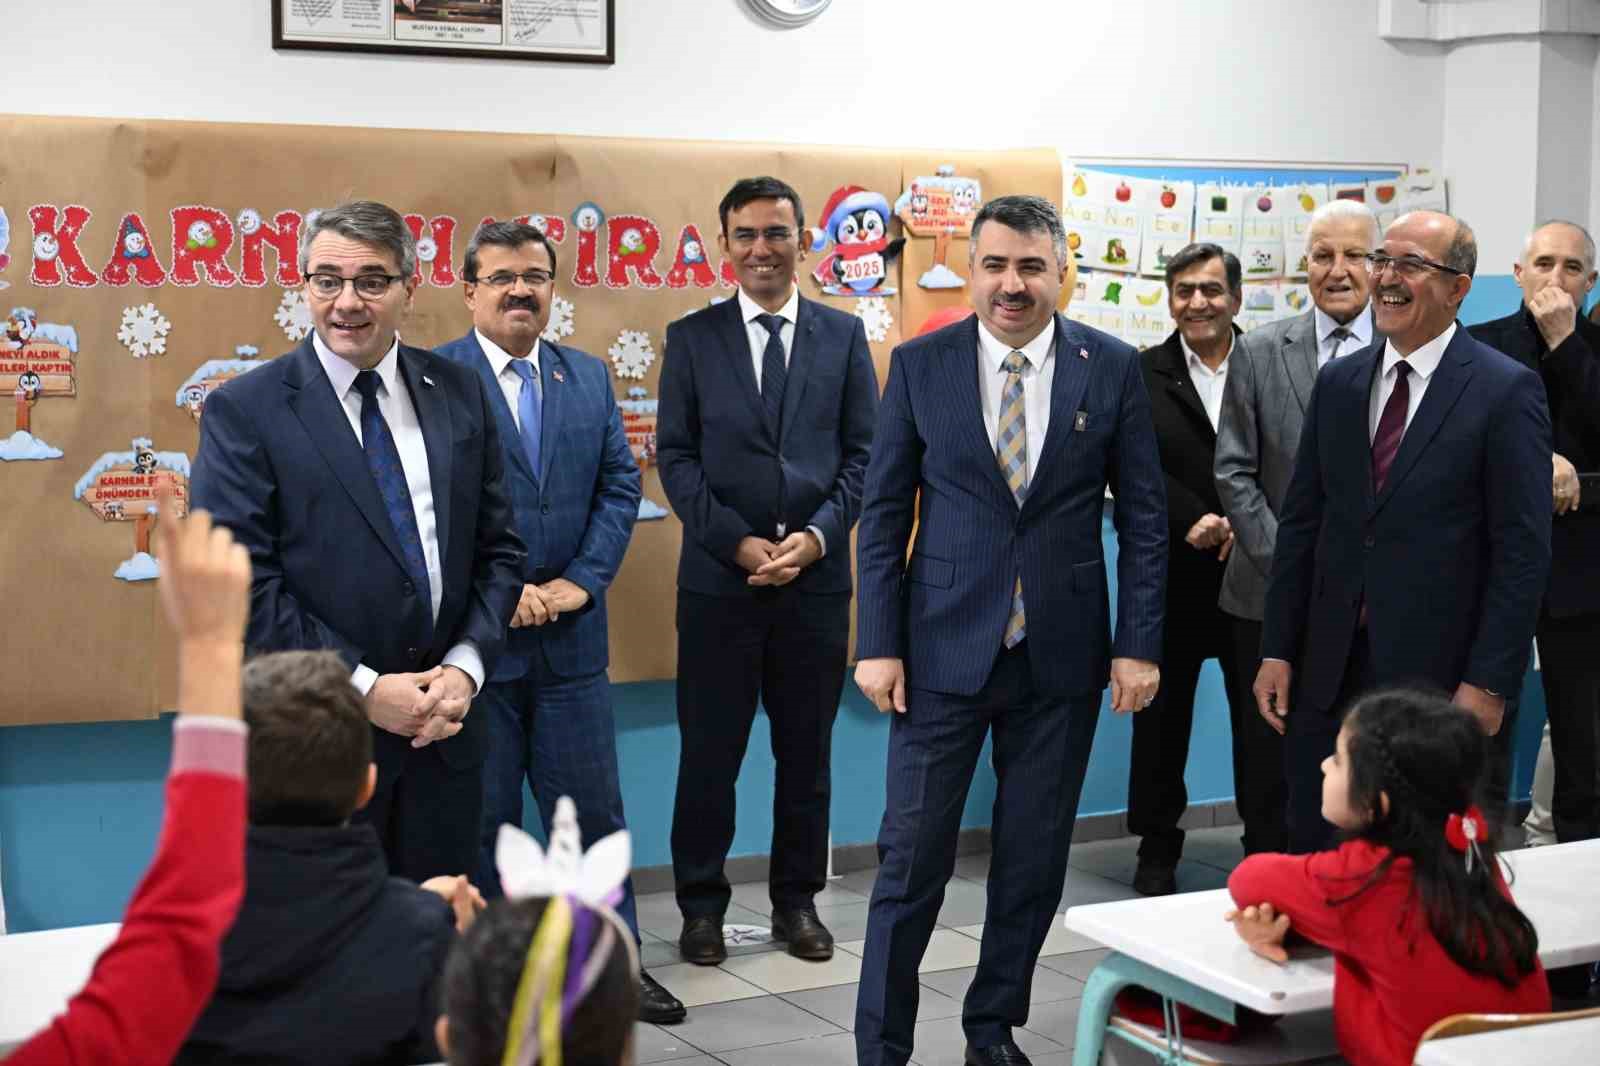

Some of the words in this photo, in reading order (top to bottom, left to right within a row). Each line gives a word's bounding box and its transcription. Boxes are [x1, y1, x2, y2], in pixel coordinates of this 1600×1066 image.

[28, 204, 305, 287] KARN
[846, 261, 879, 278] 2025
[27, 349, 60, 359] ALDIK
[31, 362, 73, 373] KAPTIK
[100, 475, 144, 486] KARNEM
[95, 487, 150, 499] ÖNÜMDEN
